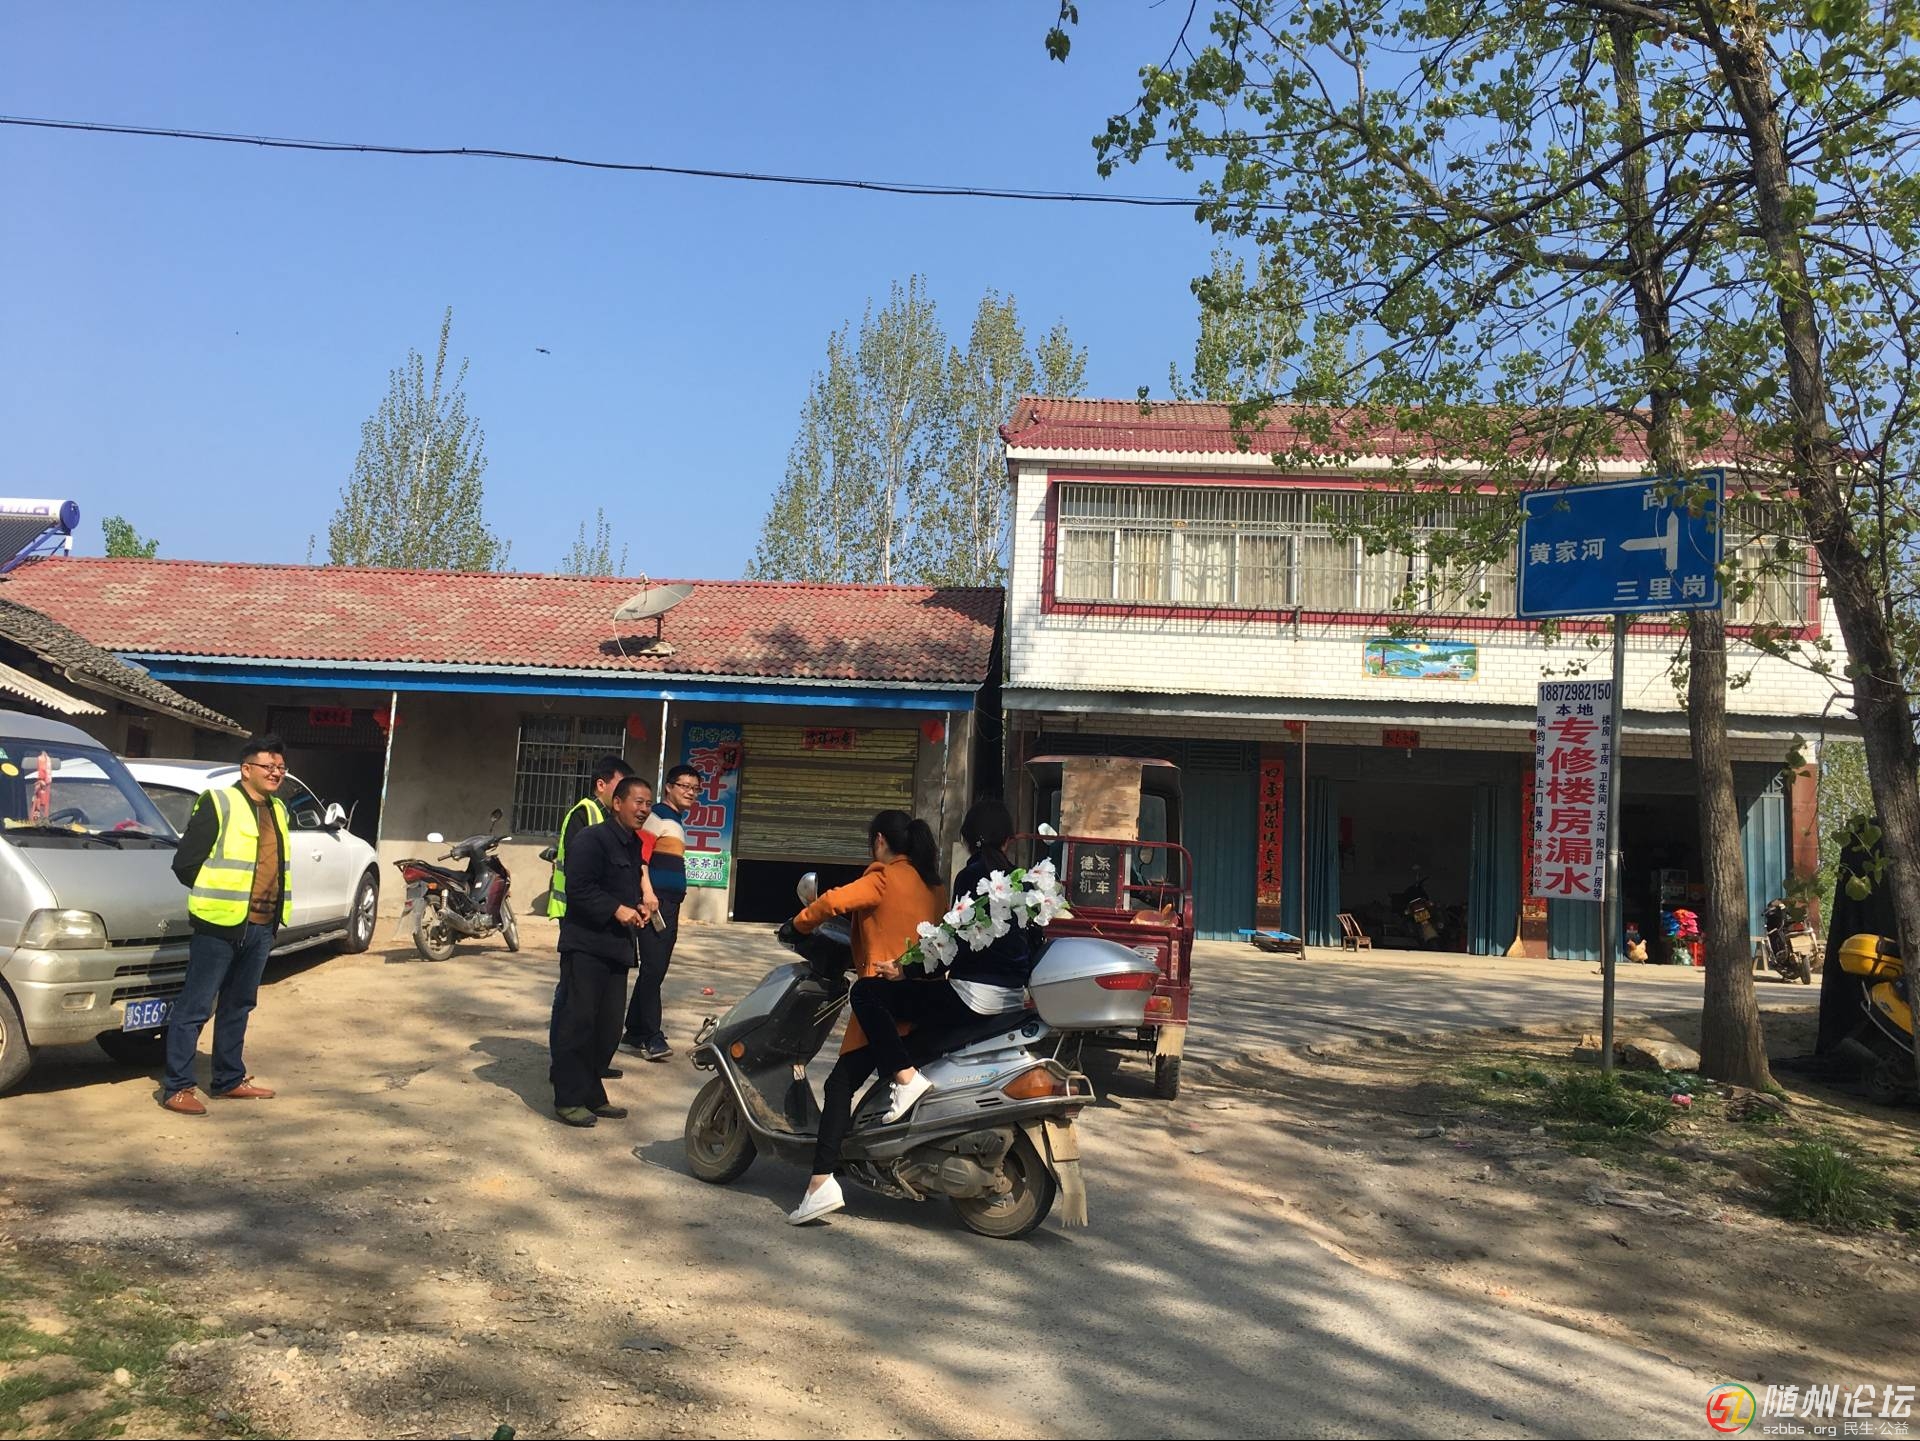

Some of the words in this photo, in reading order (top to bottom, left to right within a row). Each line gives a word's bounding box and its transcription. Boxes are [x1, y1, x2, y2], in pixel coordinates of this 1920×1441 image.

[1529, 538, 1606, 566] 黄家河
[1613, 575, 1706, 601] 三里岗
[1540, 682, 1612, 701] 18872982150
[1556, 704, 1594, 716] 本地
[1601, 714, 1610, 737] 楼房
[1536, 716, 1546, 770] 预约时间
[1600, 743, 1610, 765] 平房
[1598, 772, 1609, 805] 卫生间
[1535, 777, 1544, 832] 上门服务
[1544, 717, 1599, 895] 专修楼房漏水
[1595, 838, 1605, 860] 阳台
[684, 857, 725, 870] 零茶叶
[1080, 852, 1110, 871] 德系
[1079, 879, 1110, 895] 机车
